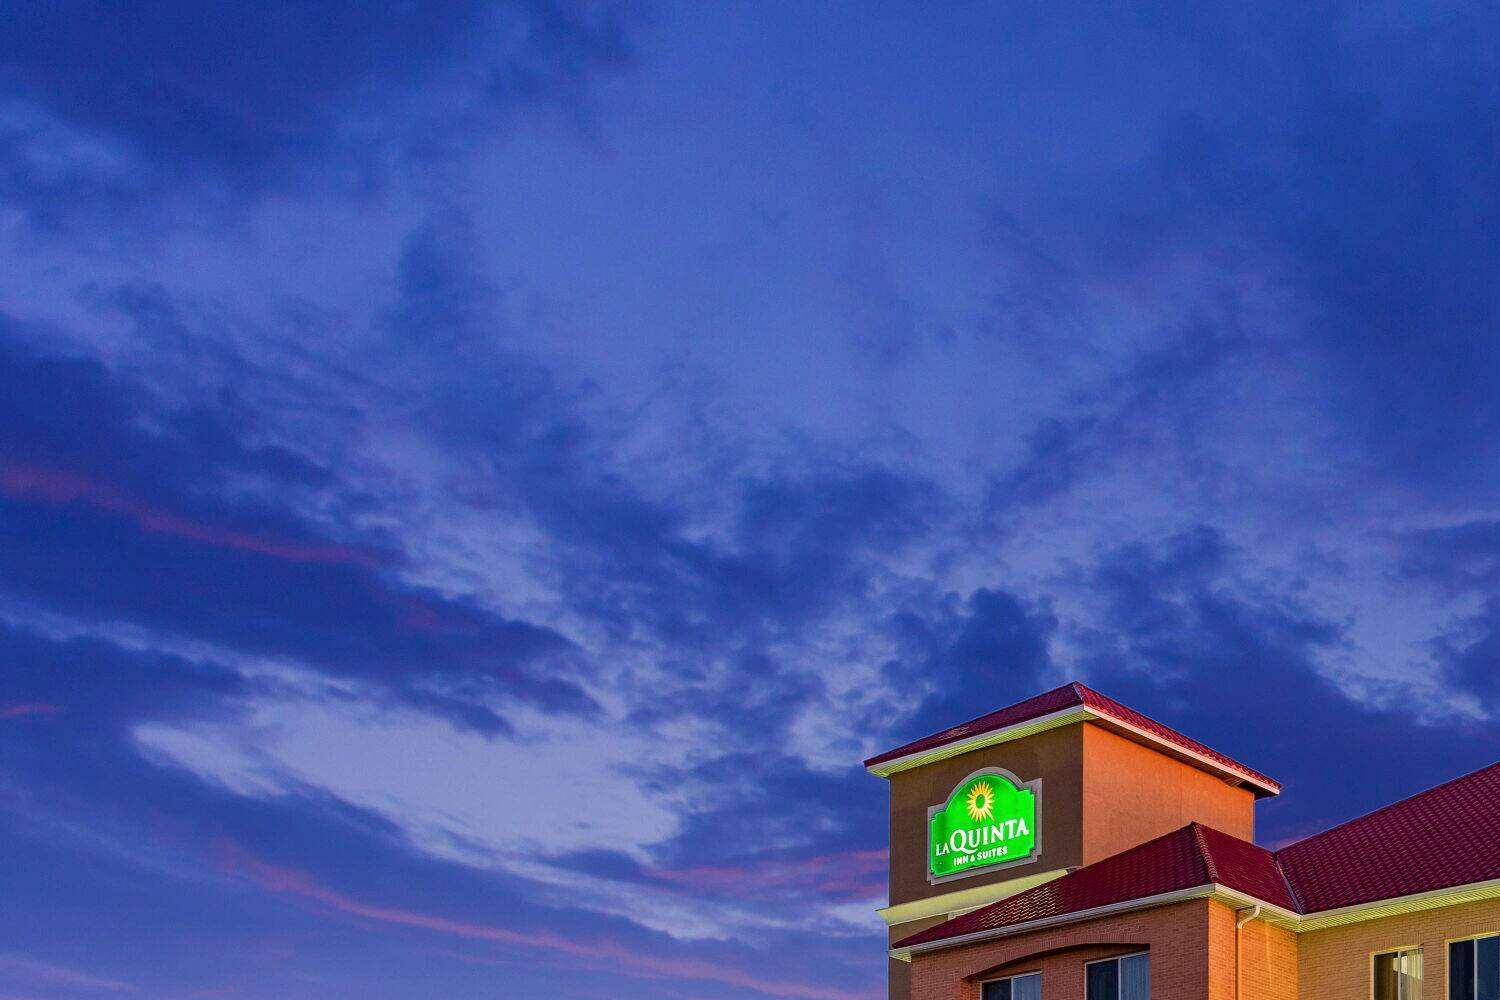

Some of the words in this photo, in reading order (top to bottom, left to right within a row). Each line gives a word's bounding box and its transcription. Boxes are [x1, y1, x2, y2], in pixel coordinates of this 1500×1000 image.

[935, 843, 950, 856] LA
[949, 817, 1030, 855] QUINTA
[953, 856, 969, 866] INN
[976, 845, 1008, 860] SUITES
